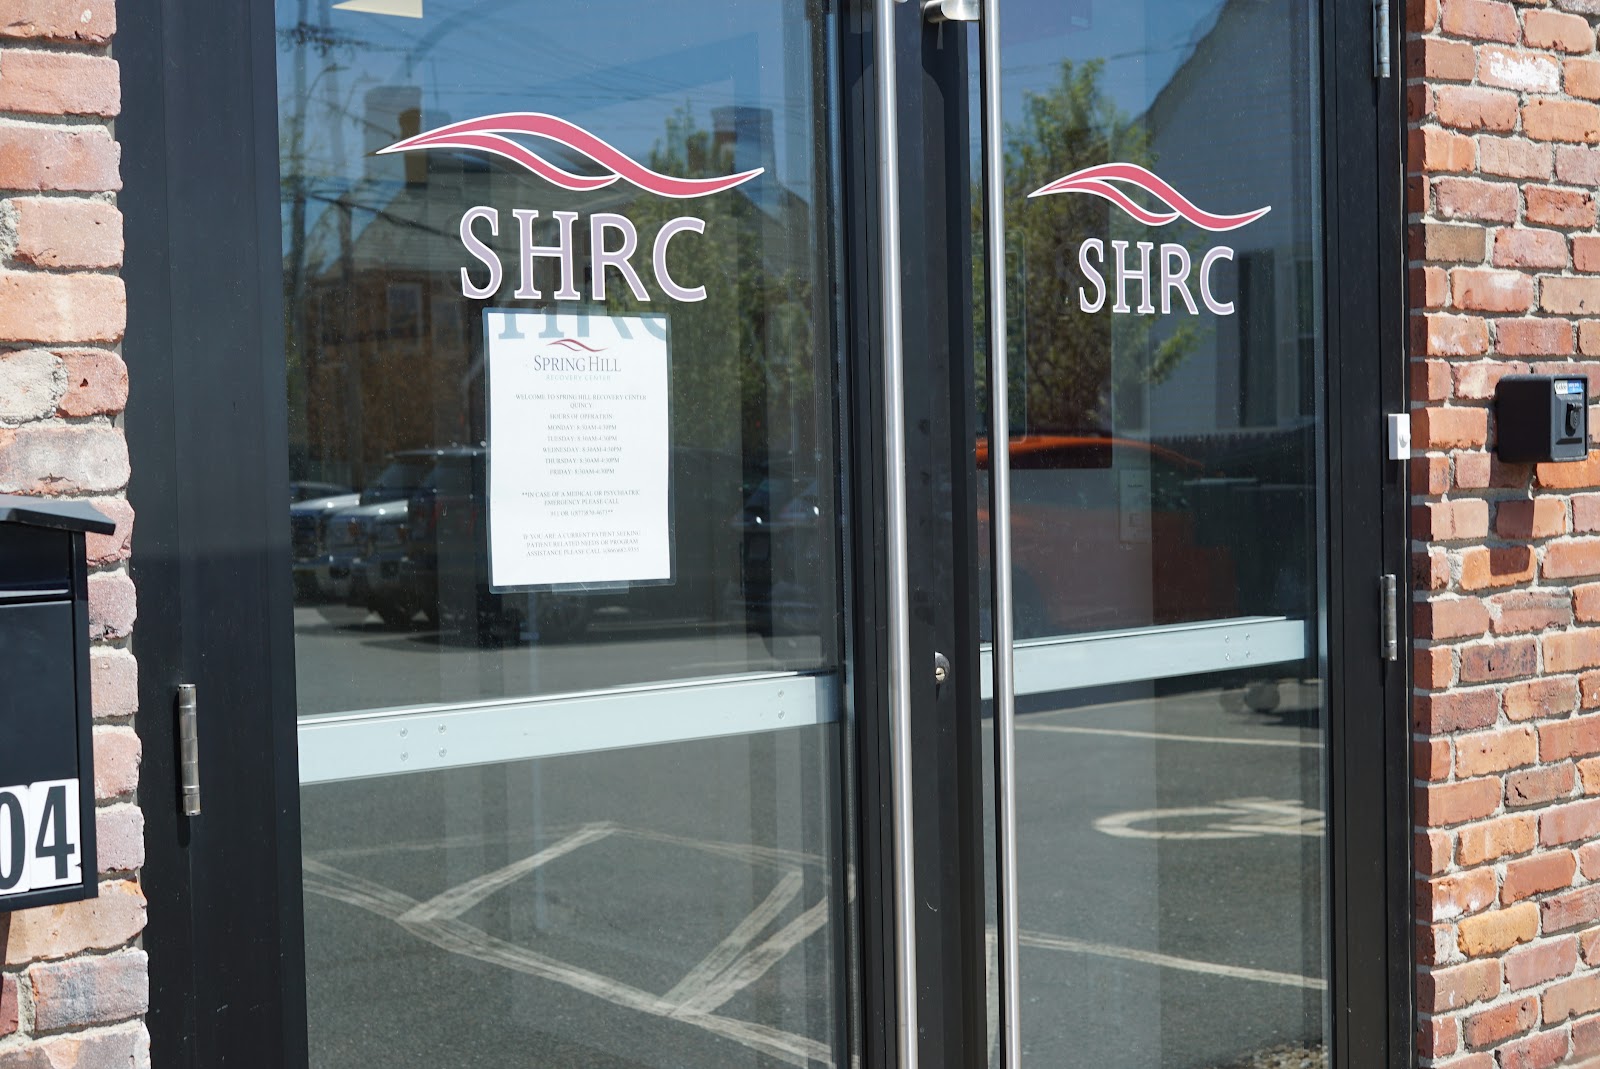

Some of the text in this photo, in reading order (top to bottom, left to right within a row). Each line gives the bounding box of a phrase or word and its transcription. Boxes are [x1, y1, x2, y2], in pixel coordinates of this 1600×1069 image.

[459, 206, 707, 302] SHRC
[1078, 238, 1235, 315] SHRC
[534, 355, 621, 372] SPRING HILL
[552, 540, 580, 548] RELATED
[0, 785, 75, 890] 04
